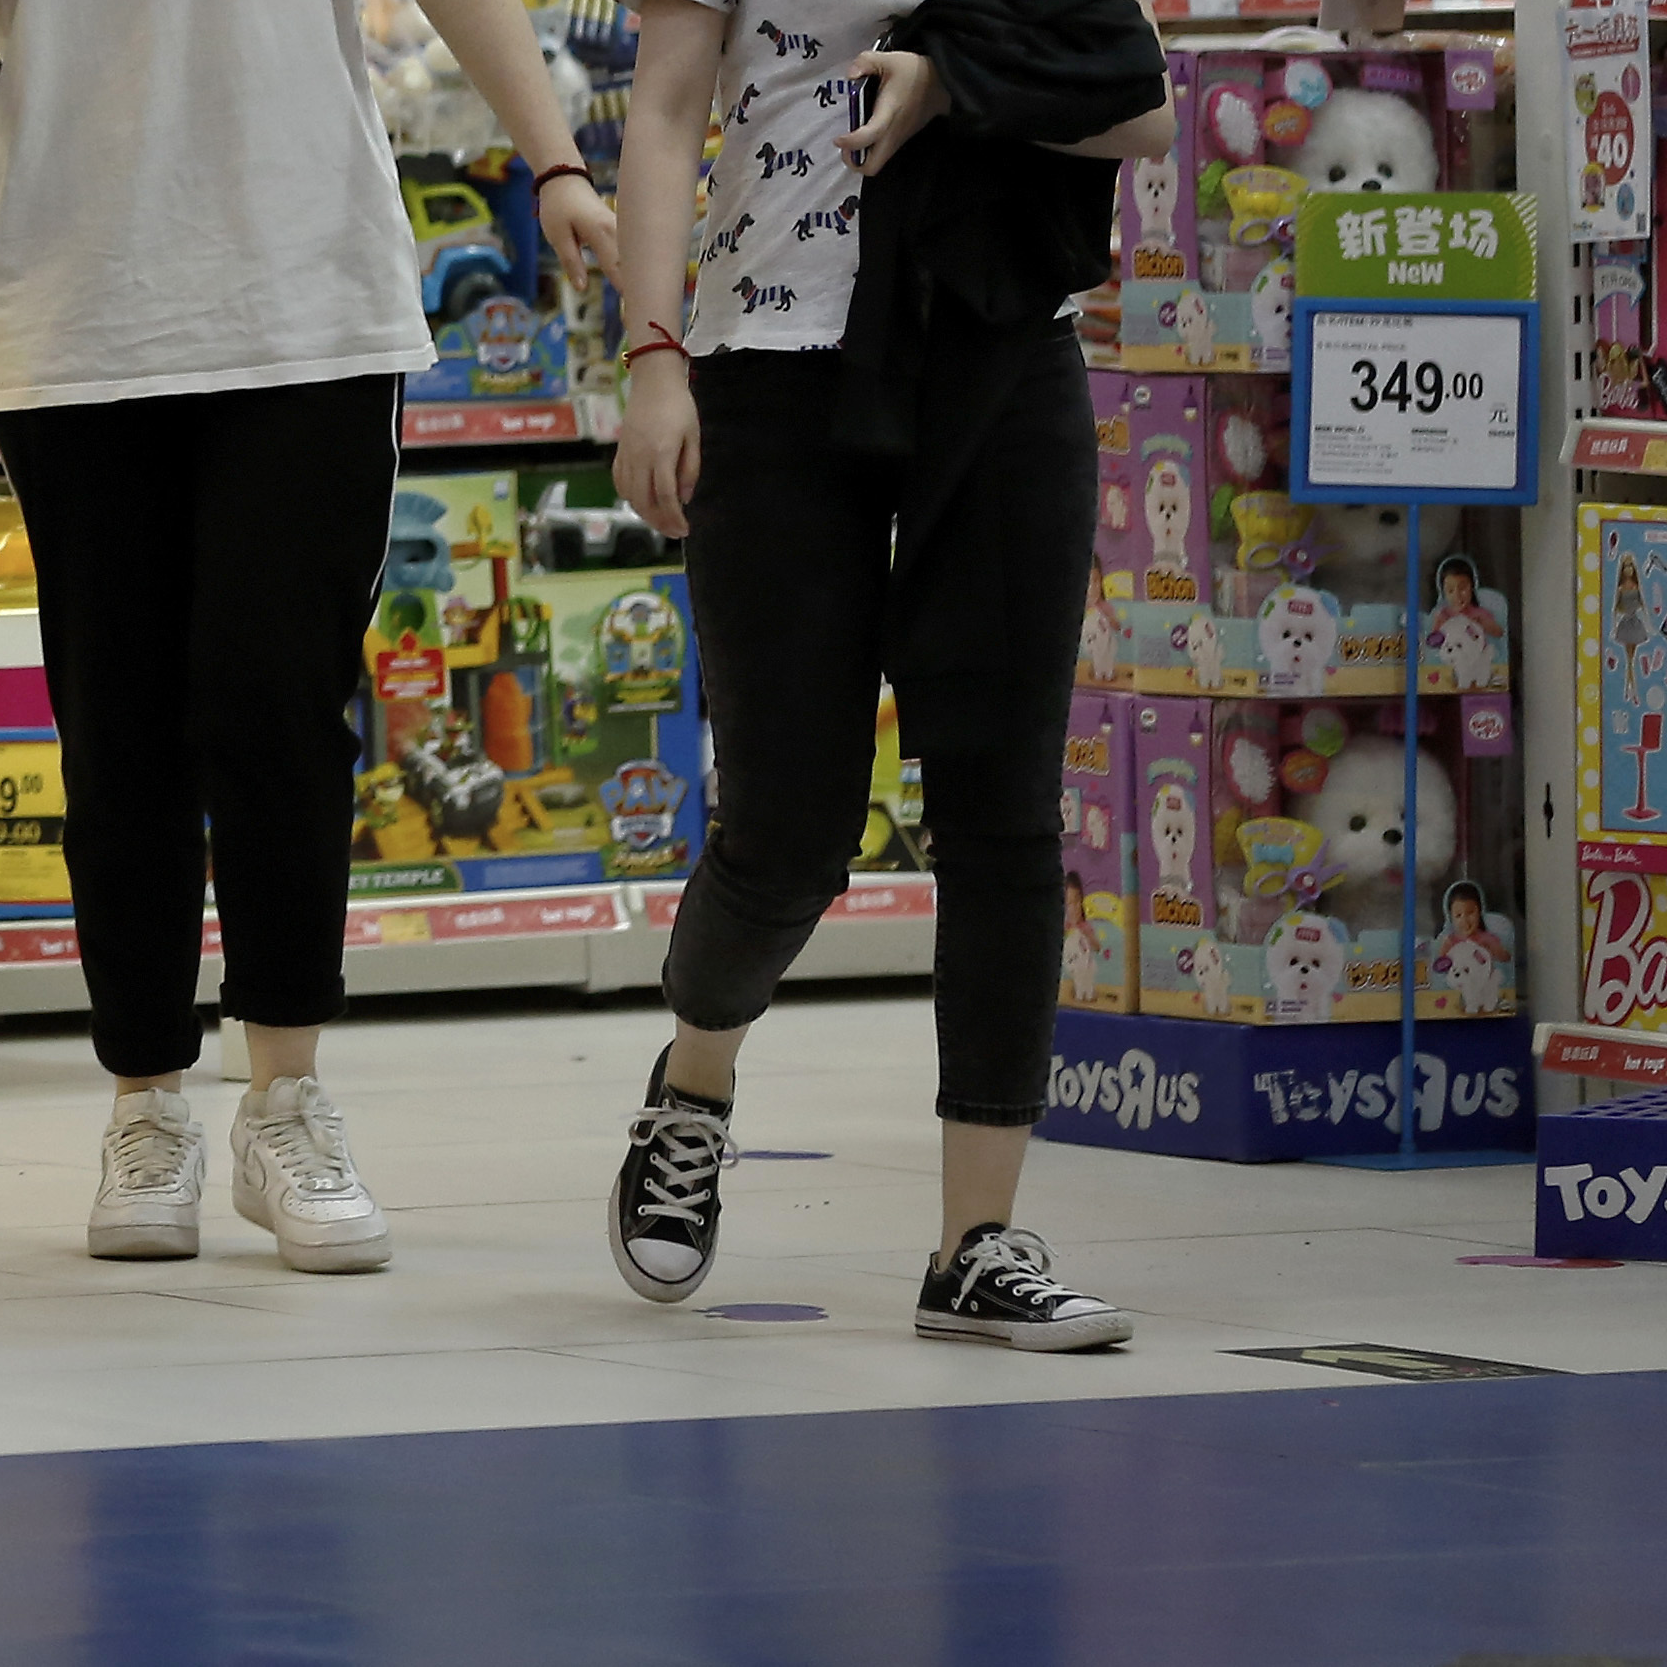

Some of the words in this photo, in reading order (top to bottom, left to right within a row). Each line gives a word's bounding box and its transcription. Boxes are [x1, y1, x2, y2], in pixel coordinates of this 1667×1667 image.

[1336, 205, 1500, 260] 新登场
[1134, 249, 1184, 278] Bichon
[1350, 358, 1484, 413] 349.00
[1490, 403, 1509, 424] 元
[1145, 570, 1196, 601] Bichon
[376, 867, 445, 888] TEMPLE
[1151, 893, 1202, 927] Bichon
